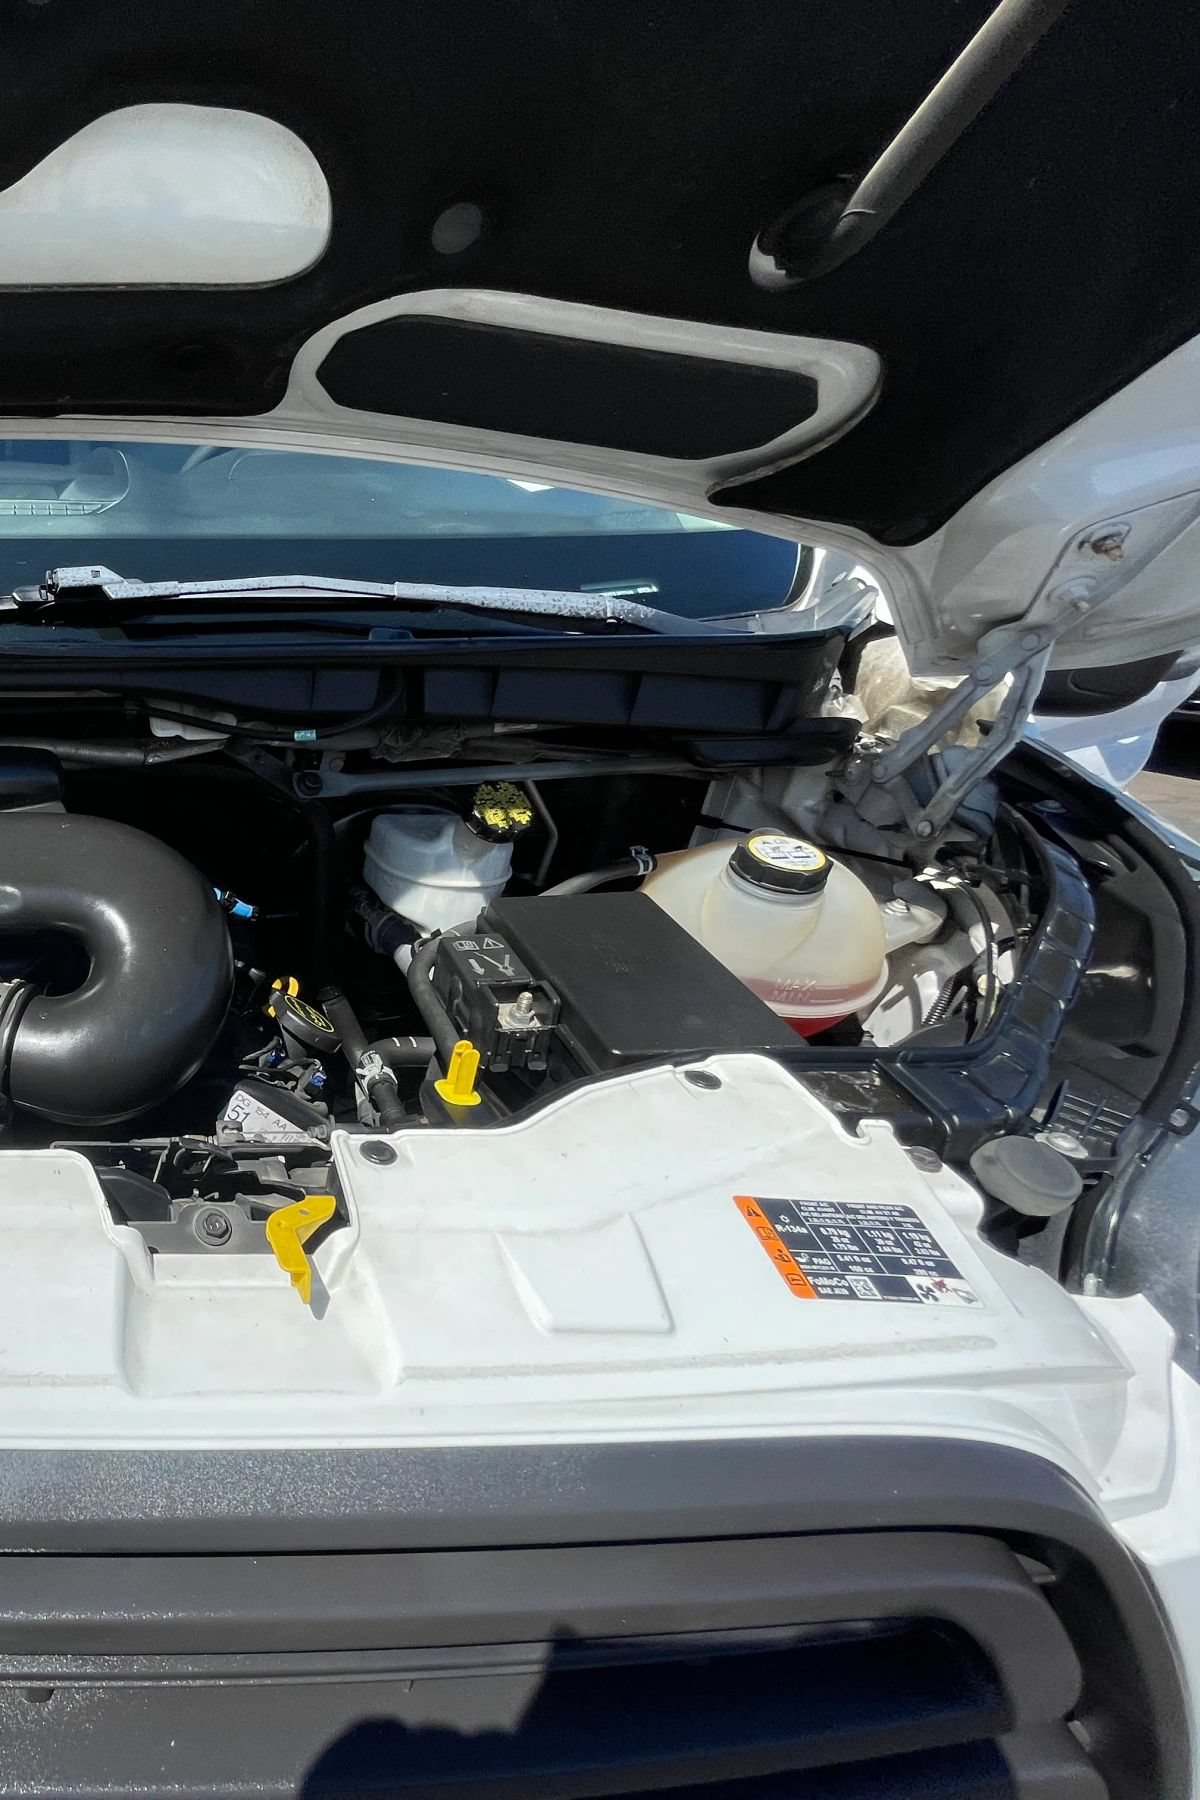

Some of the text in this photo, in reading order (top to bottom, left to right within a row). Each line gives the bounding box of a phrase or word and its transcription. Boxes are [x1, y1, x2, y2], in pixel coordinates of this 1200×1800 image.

[776, 978, 818, 991] MAX
[773, 990, 812, 1003] MIN
[227, 1104, 250, 1124] 51
[235, 1093, 251, 1107] DG
[272, 1117, 287, 1130] AA
[774, 1224, 808, 1233] R-134a
[836, 1228, 851, 1237] kg
[880, 1231, 895, 1240] kg
[917, 1233, 932, 1242] kg
[811, 1257, 832, 1265] PAG
[806, 1276, 850, 1286] FoMoCo
